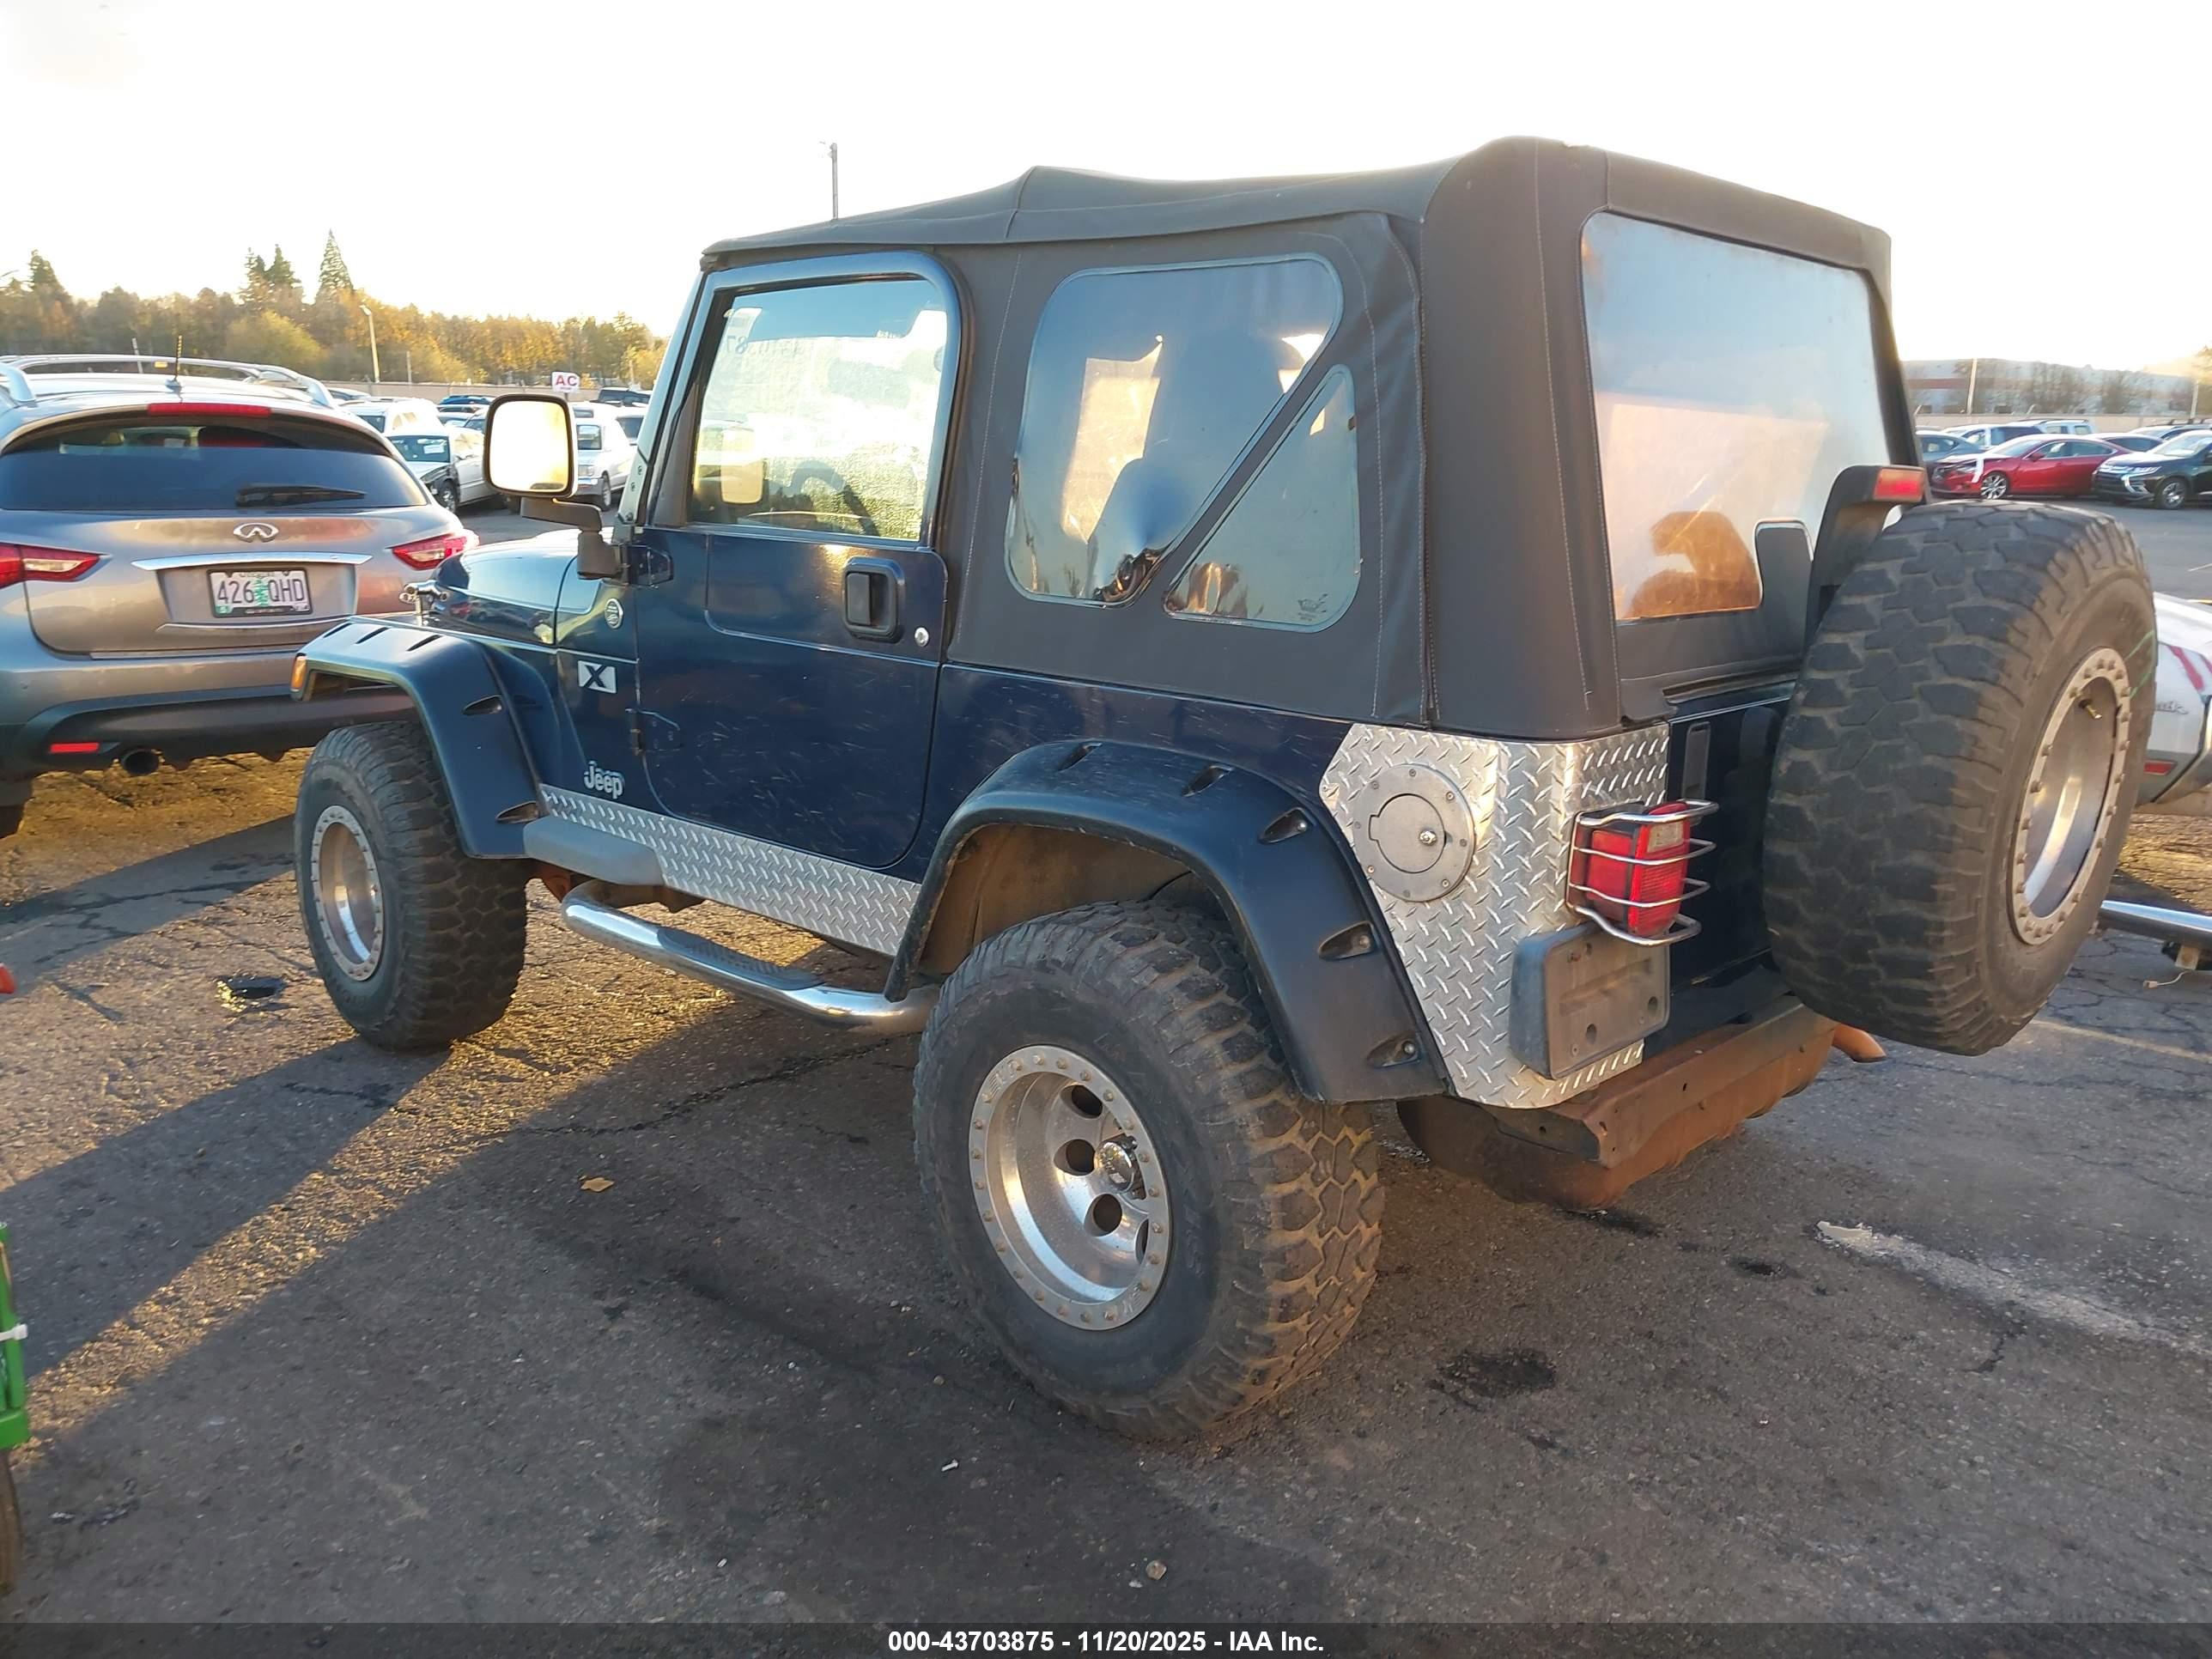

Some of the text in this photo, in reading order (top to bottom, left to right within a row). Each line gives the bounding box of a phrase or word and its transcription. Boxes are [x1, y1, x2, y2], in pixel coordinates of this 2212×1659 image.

[556, 374, 578, 386] AC
[218, 579, 305, 604] 426 QHD
[584, 664, 606, 689] X
[583, 760, 624, 799] Jeep
